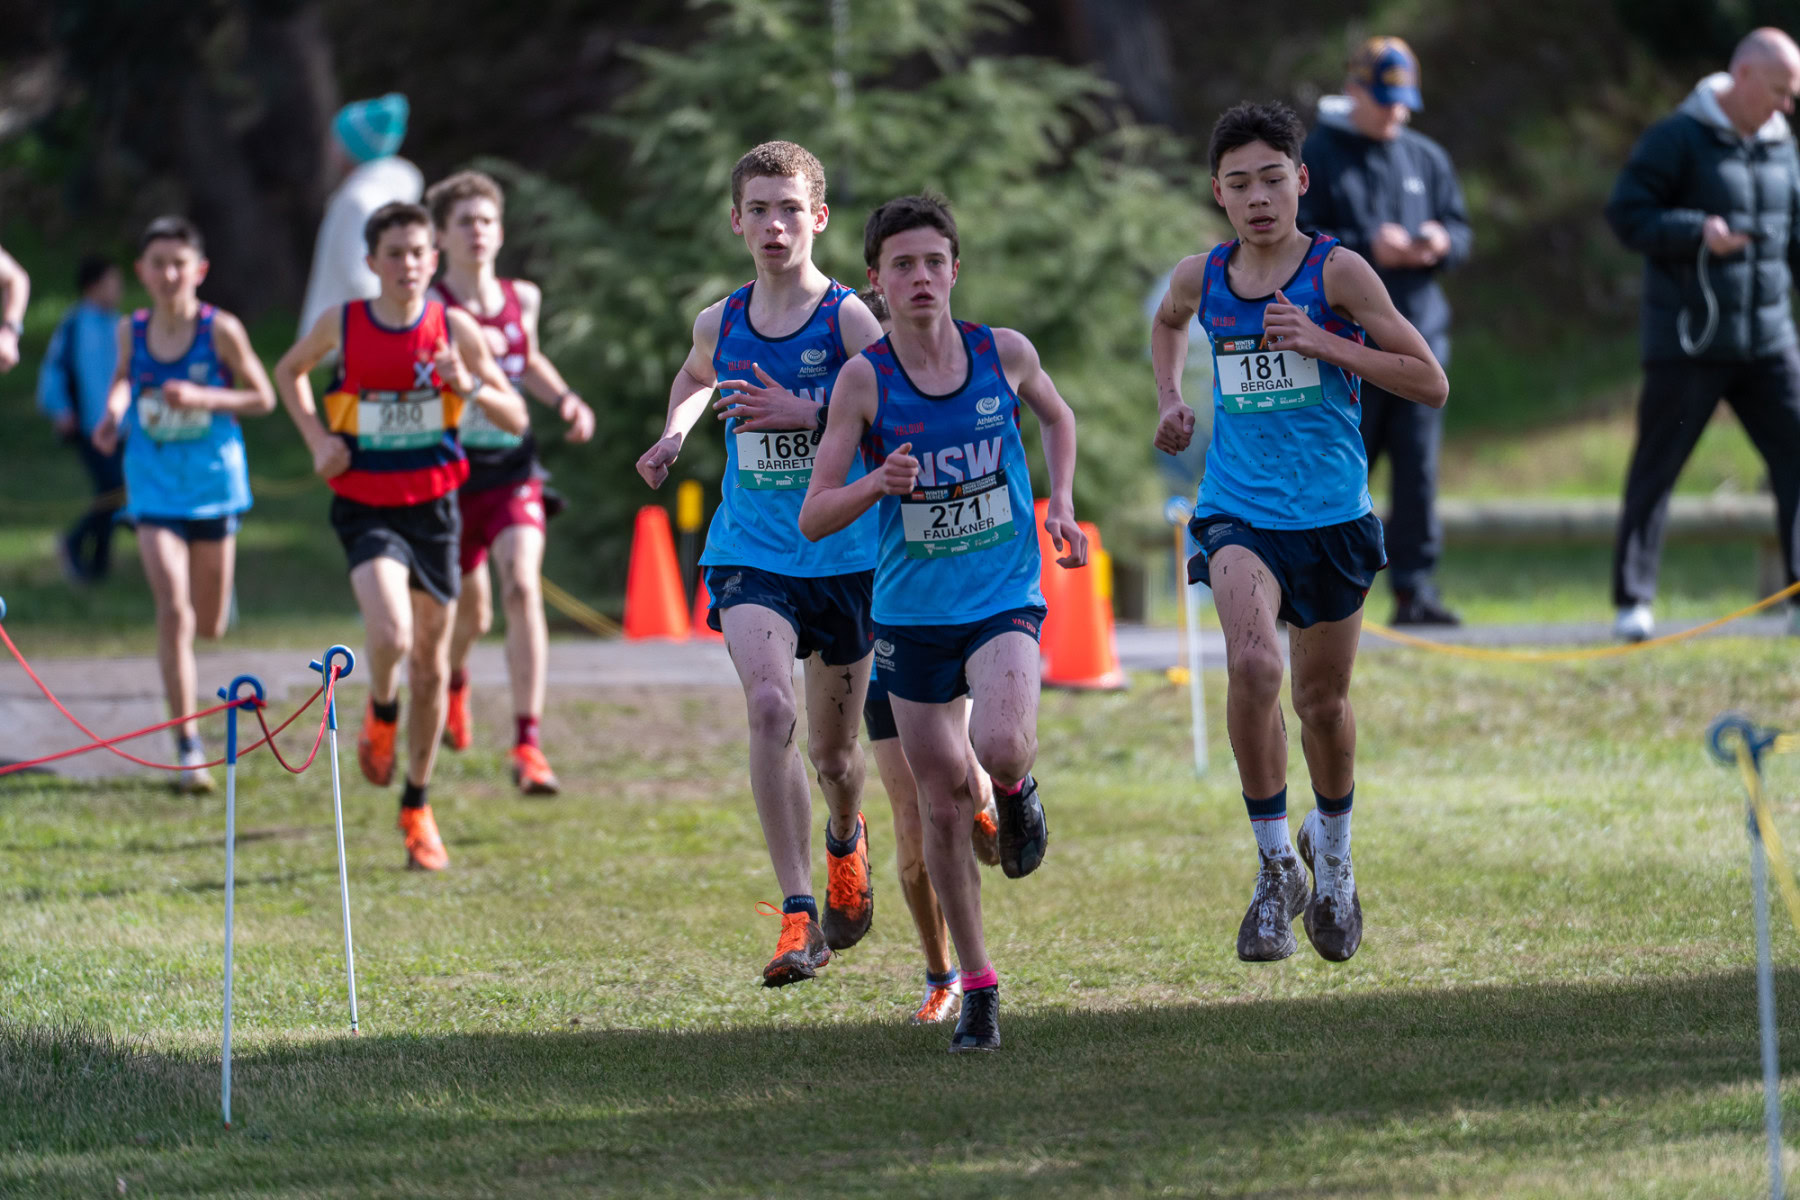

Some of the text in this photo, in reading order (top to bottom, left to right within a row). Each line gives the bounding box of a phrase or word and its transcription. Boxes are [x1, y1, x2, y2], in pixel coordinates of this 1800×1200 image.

[1212, 316, 1236, 327] VALOUR
[800, 366, 827, 374] Athletics
[1240, 352, 1286, 380] 181
[1241, 378, 1293, 392] BERGAN
[977, 414, 1004, 426] Athletics
[894, 421, 925, 436] VALOUR
[760, 433, 810, 459] 168
[757, 457, 816, 470] BARRETT
[911, 435, 1003, 487] NSW
[930, 497, 982, 528] 271
[924, 518, 995, 539] FAULKNER
[1012, 618, 1036, 634] VALOUR
